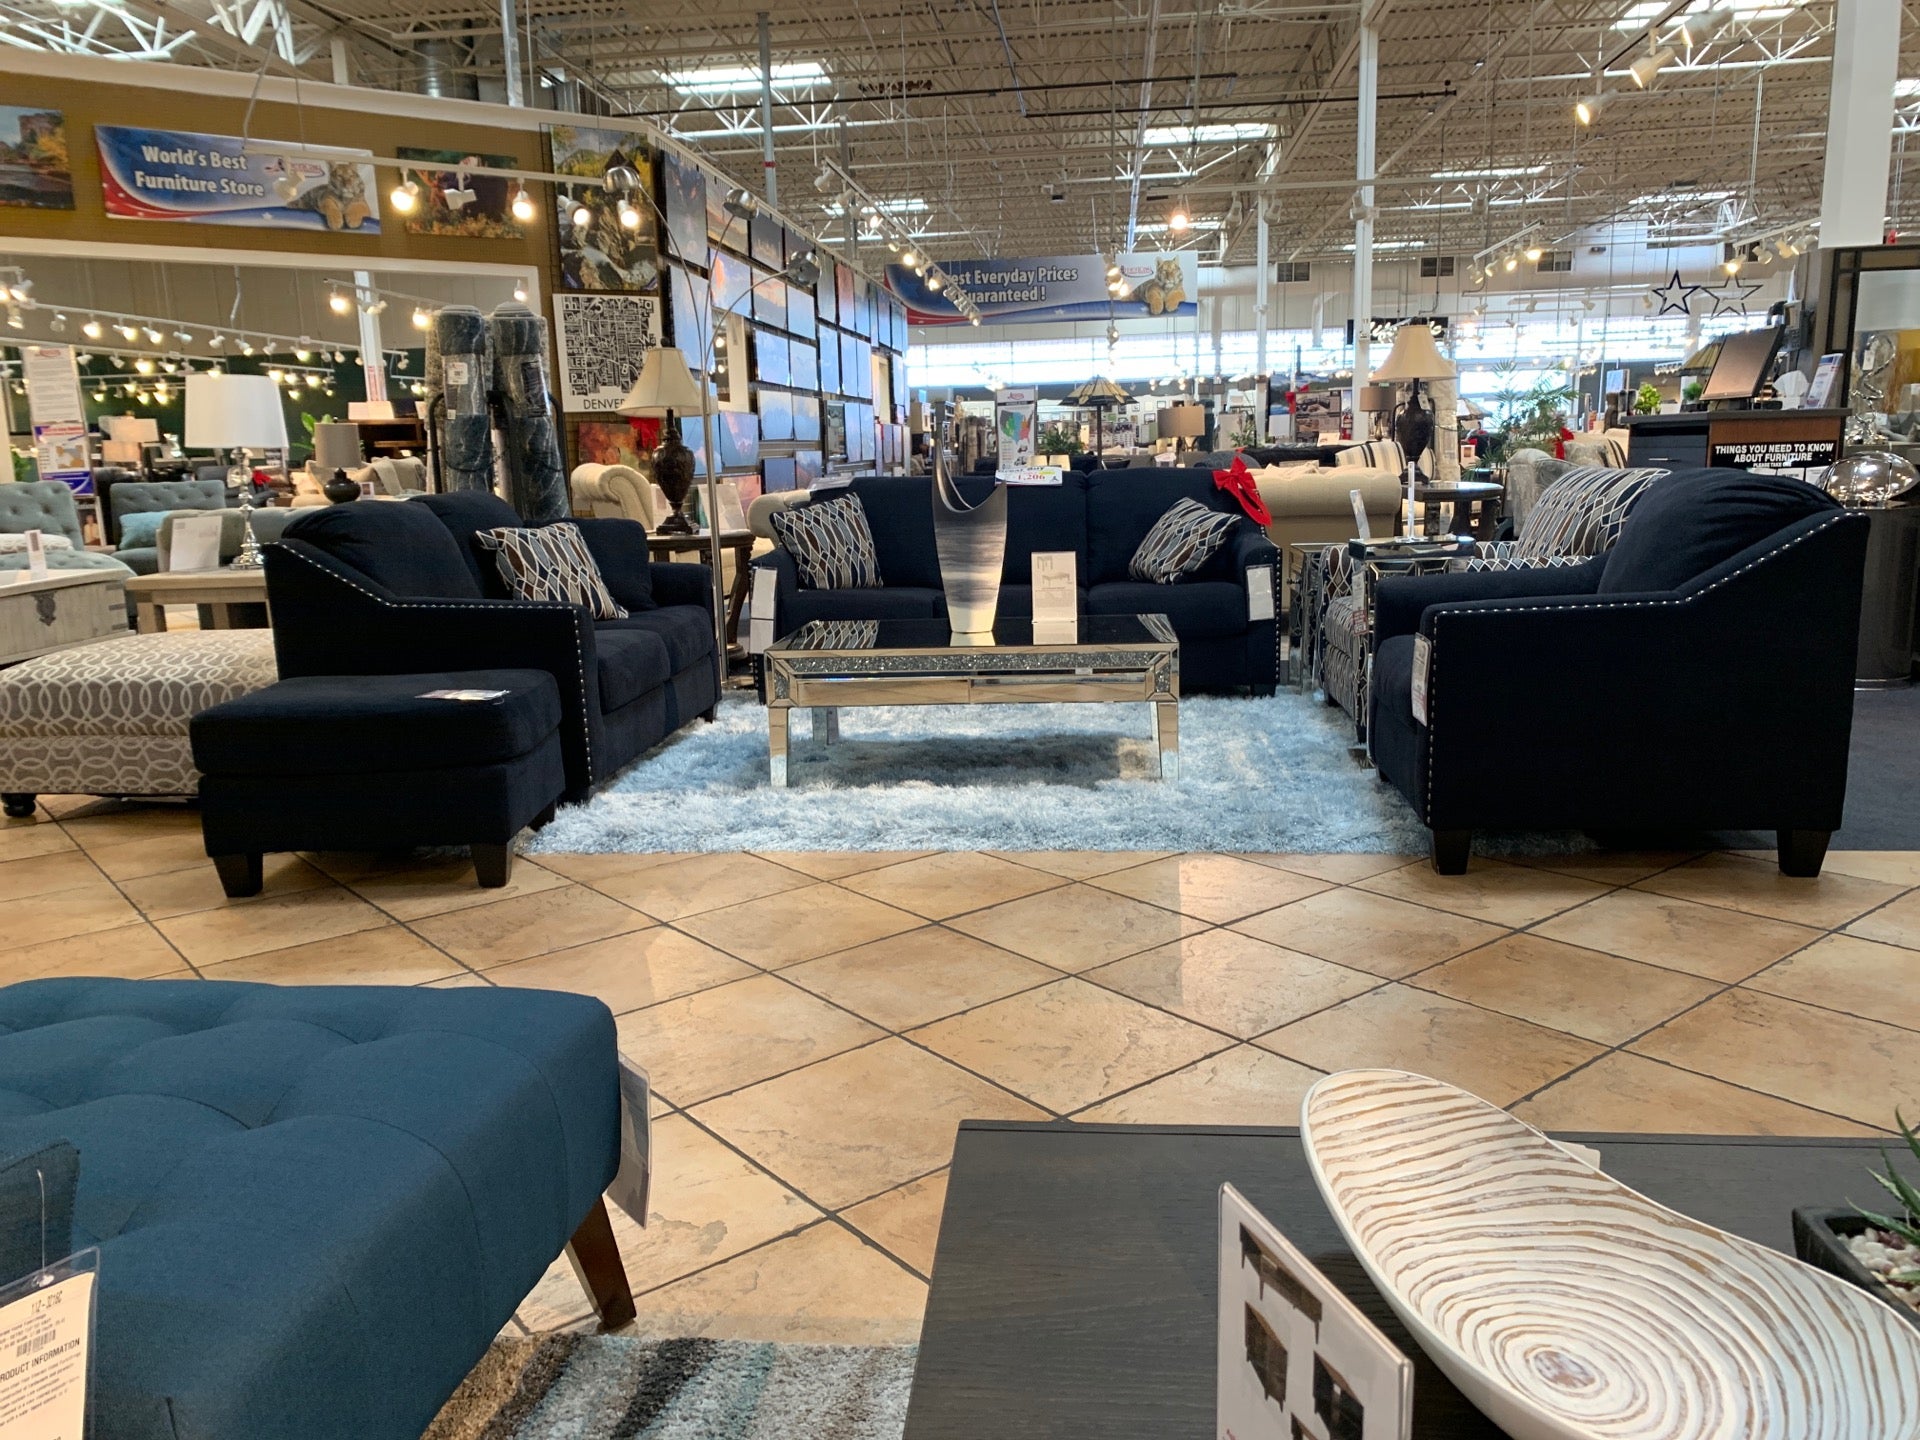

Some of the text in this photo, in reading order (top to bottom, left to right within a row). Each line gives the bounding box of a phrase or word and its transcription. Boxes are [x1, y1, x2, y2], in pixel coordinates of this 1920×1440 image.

[141, 145, 207, 167] World's
[210, 152, 248, 170] Best
[134, 170, 264, 197] Furniture Store
[974, 267, 1036, 285] Everyday
[1037, 265, 1078, 282] Prices
[961, 287, 1038, 304] uaranteed
[583, 399, 625, 410] DENVE
[1715, 443, 1834, 454] THINGS YOU NEED TO KNOW
[1733, 452, 1813, 463] ABOUT FURNITURE
[0, 1337, 80, 1382] RODUCT INFORMATION
